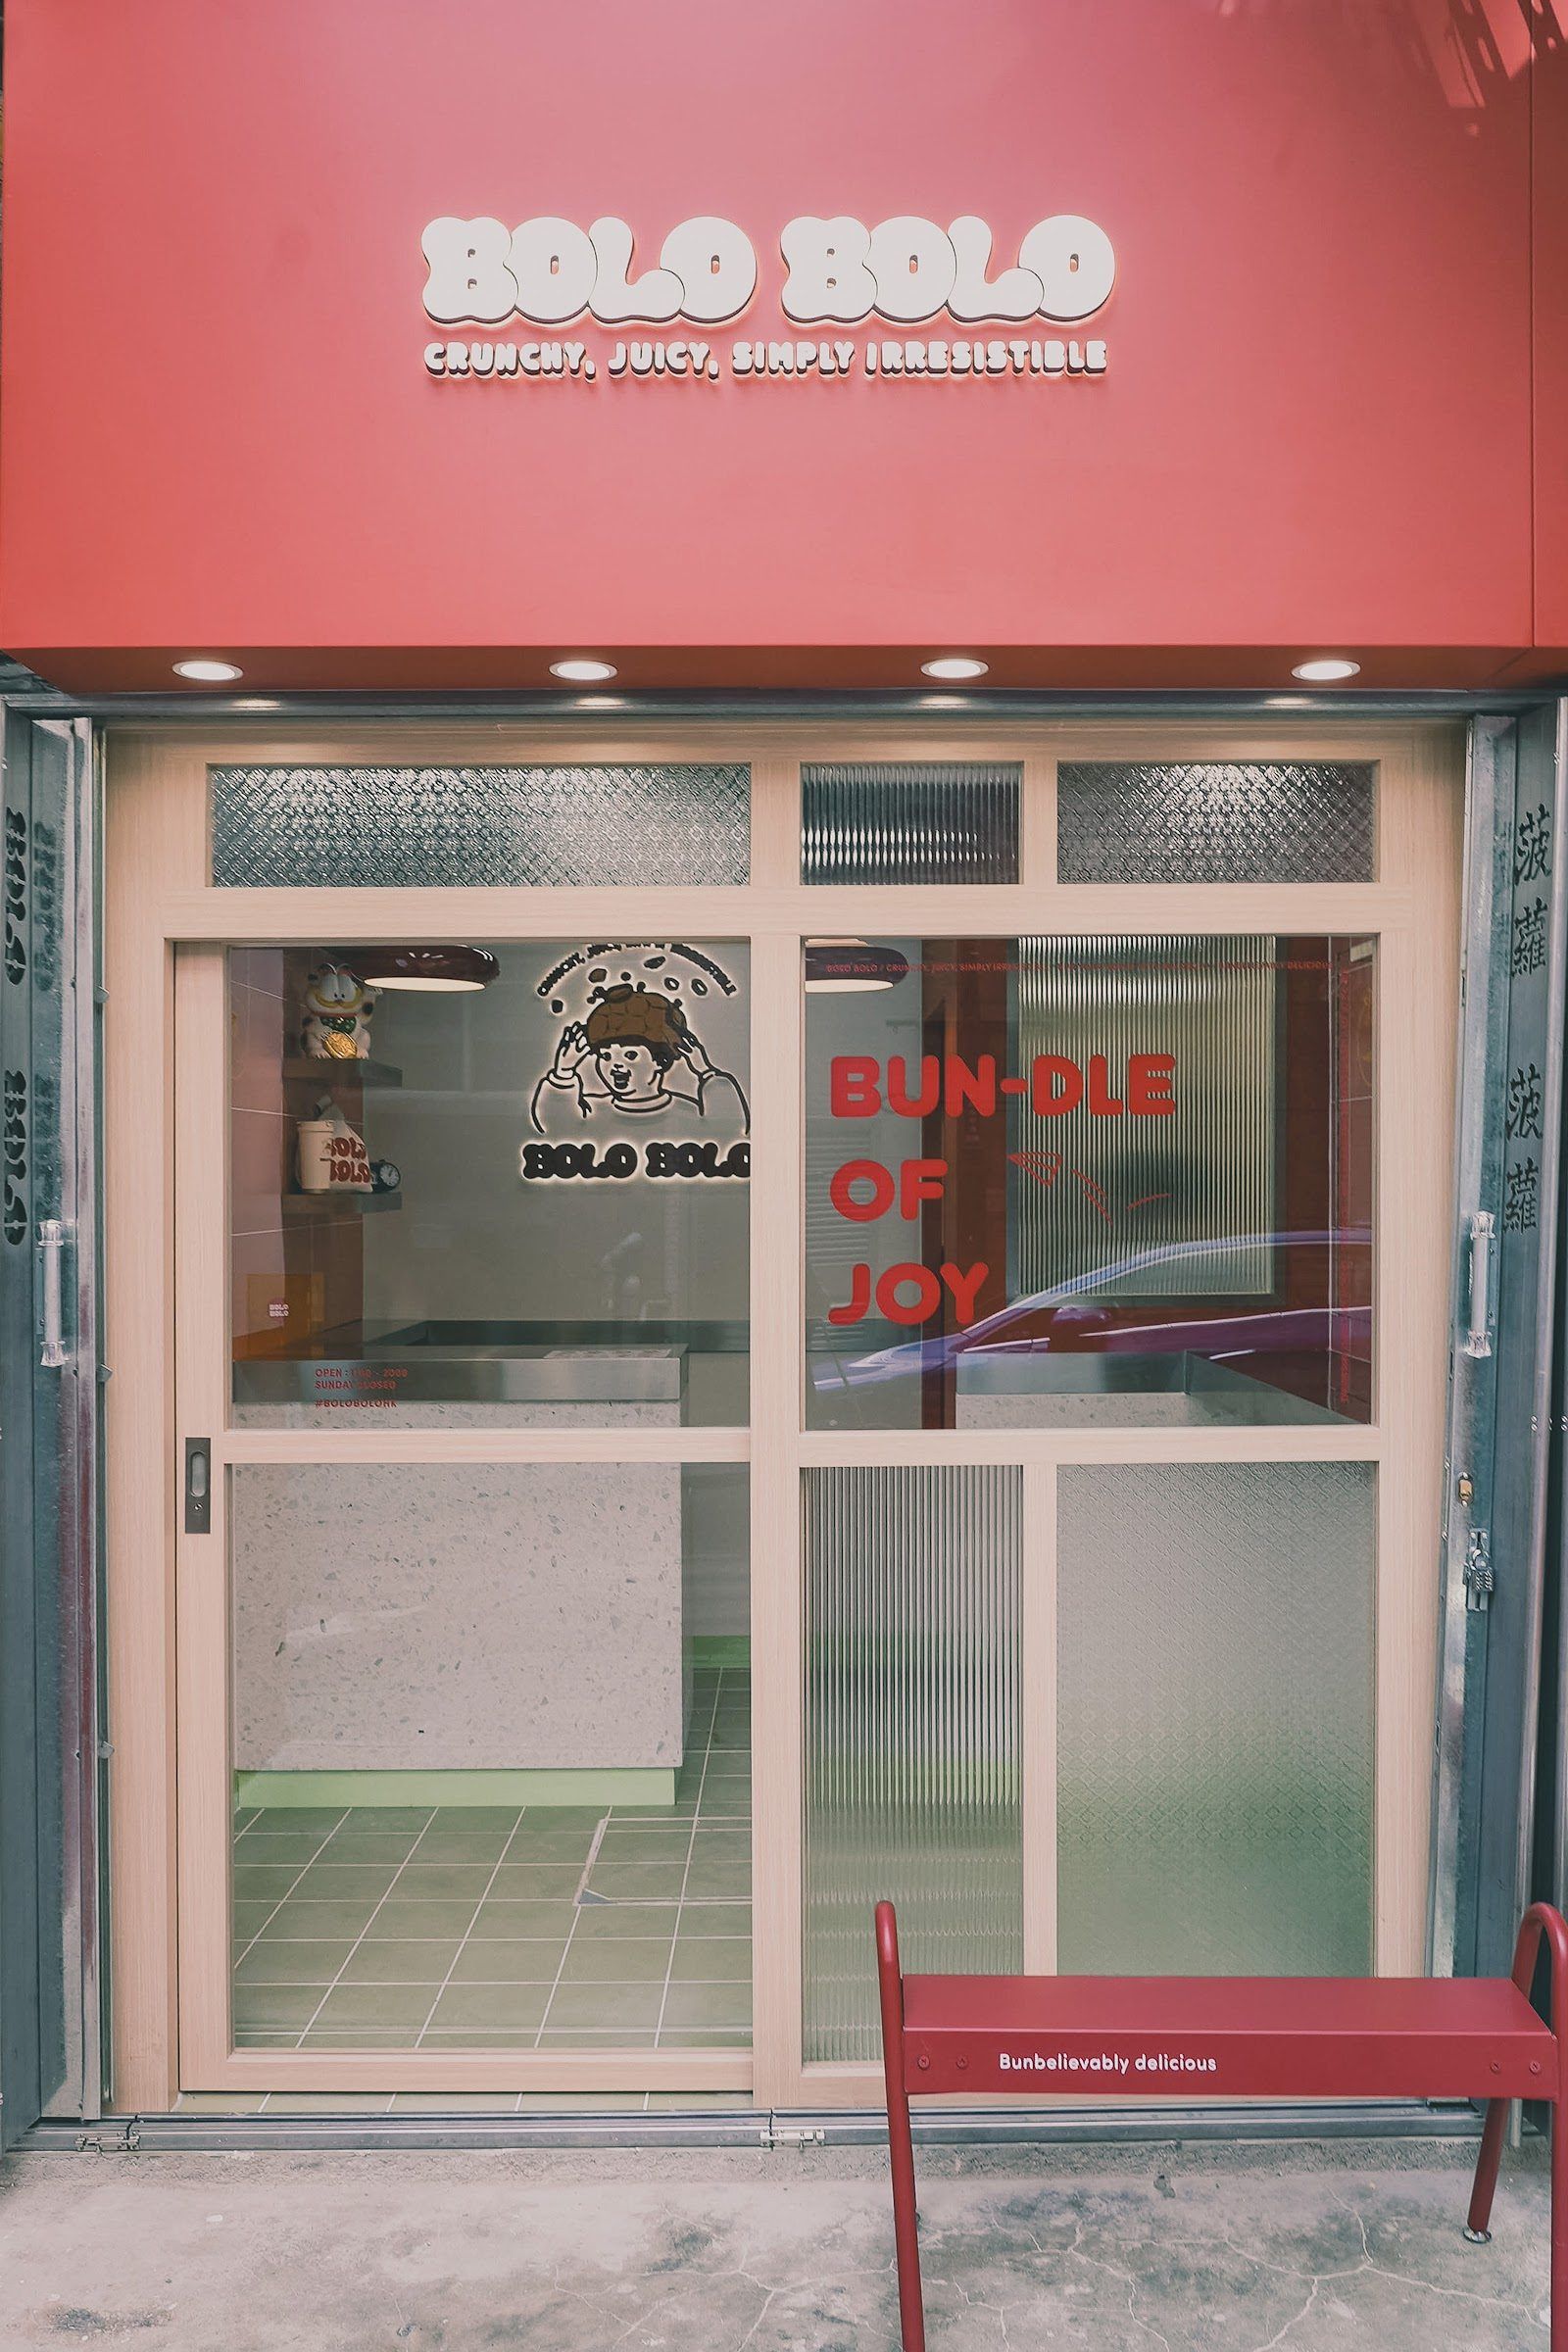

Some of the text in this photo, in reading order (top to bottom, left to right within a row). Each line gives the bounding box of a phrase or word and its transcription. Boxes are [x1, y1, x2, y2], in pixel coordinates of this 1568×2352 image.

[419, 214, 1116, 324] BOLO BOLO
[423, 339, 1108, 380] CRUNCHY, JUICY, SIMPLY IRRESISTIBLE
[829, 1053, 1177, 1118] BUN-DLE
[522, 1142, 751, 1179] BOLO BOLO
[829, 1158, 949, 1222] OF
[828, 1261, 990, 1325] JOY
[316, 1367, 342, 1377] OPEN
[999, 2052, 1217, 2075] Bunbelievably delicious
